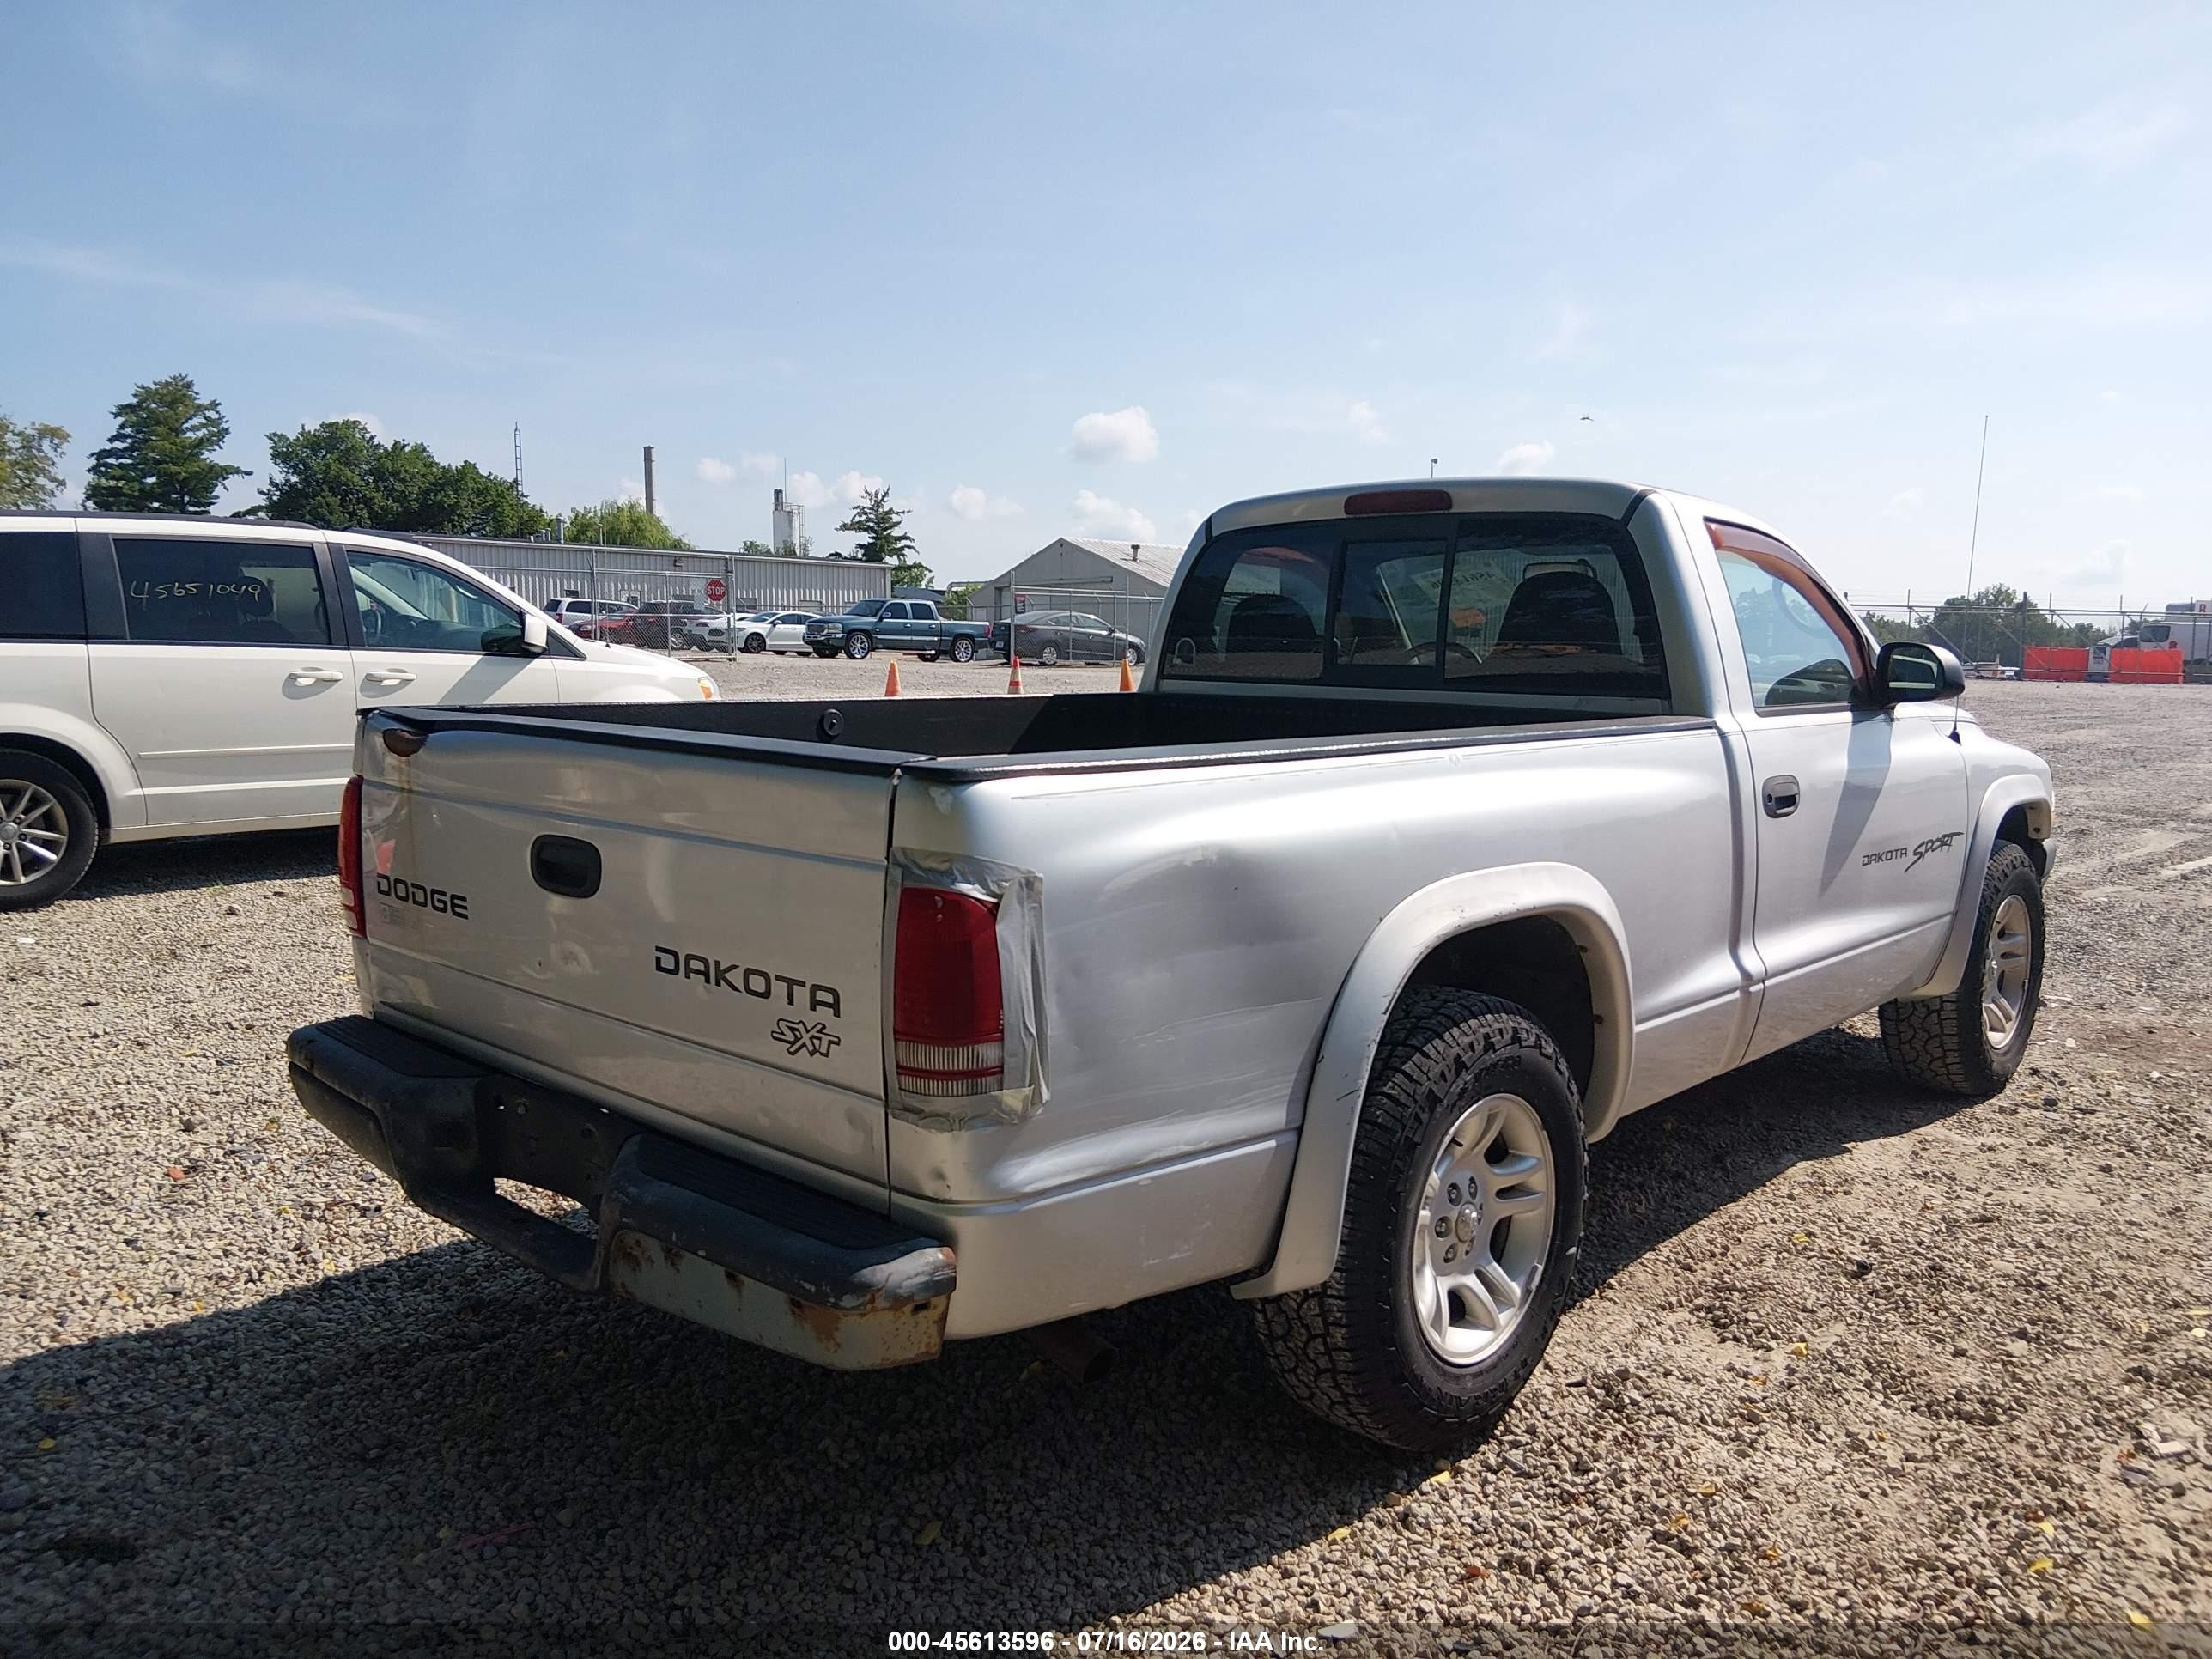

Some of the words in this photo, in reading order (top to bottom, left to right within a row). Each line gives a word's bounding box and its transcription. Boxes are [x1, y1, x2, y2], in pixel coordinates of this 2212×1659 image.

[707, 586, 726, 595] STOP
[1862, 848, 1908, 866] DAKOTA
[1904, 831, 1965, 872] SPORT
[376, 872, 469, 920] DODGE
[654, 945, 841, 1018] DAKOTA
[770, 1018, 841, 1058] SXT
